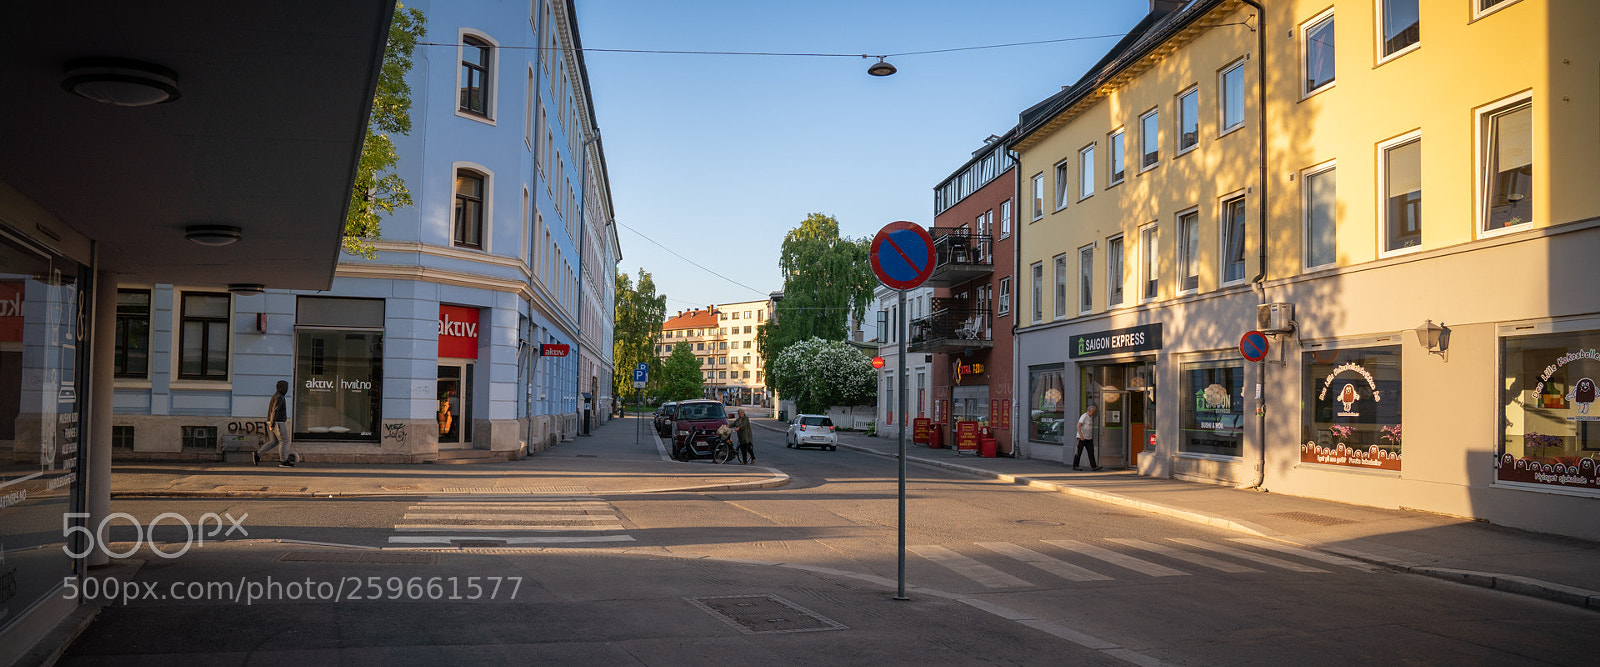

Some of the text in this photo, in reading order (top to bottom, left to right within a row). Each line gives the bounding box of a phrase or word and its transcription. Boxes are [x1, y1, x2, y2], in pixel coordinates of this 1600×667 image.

[438, 314, 477, 338] aktiv.
[1085, 332, 1145, 351] SAIGON EXPRESS
[636, 370, 643, 380] P
[305, 377, 334, 389] aktiv.
